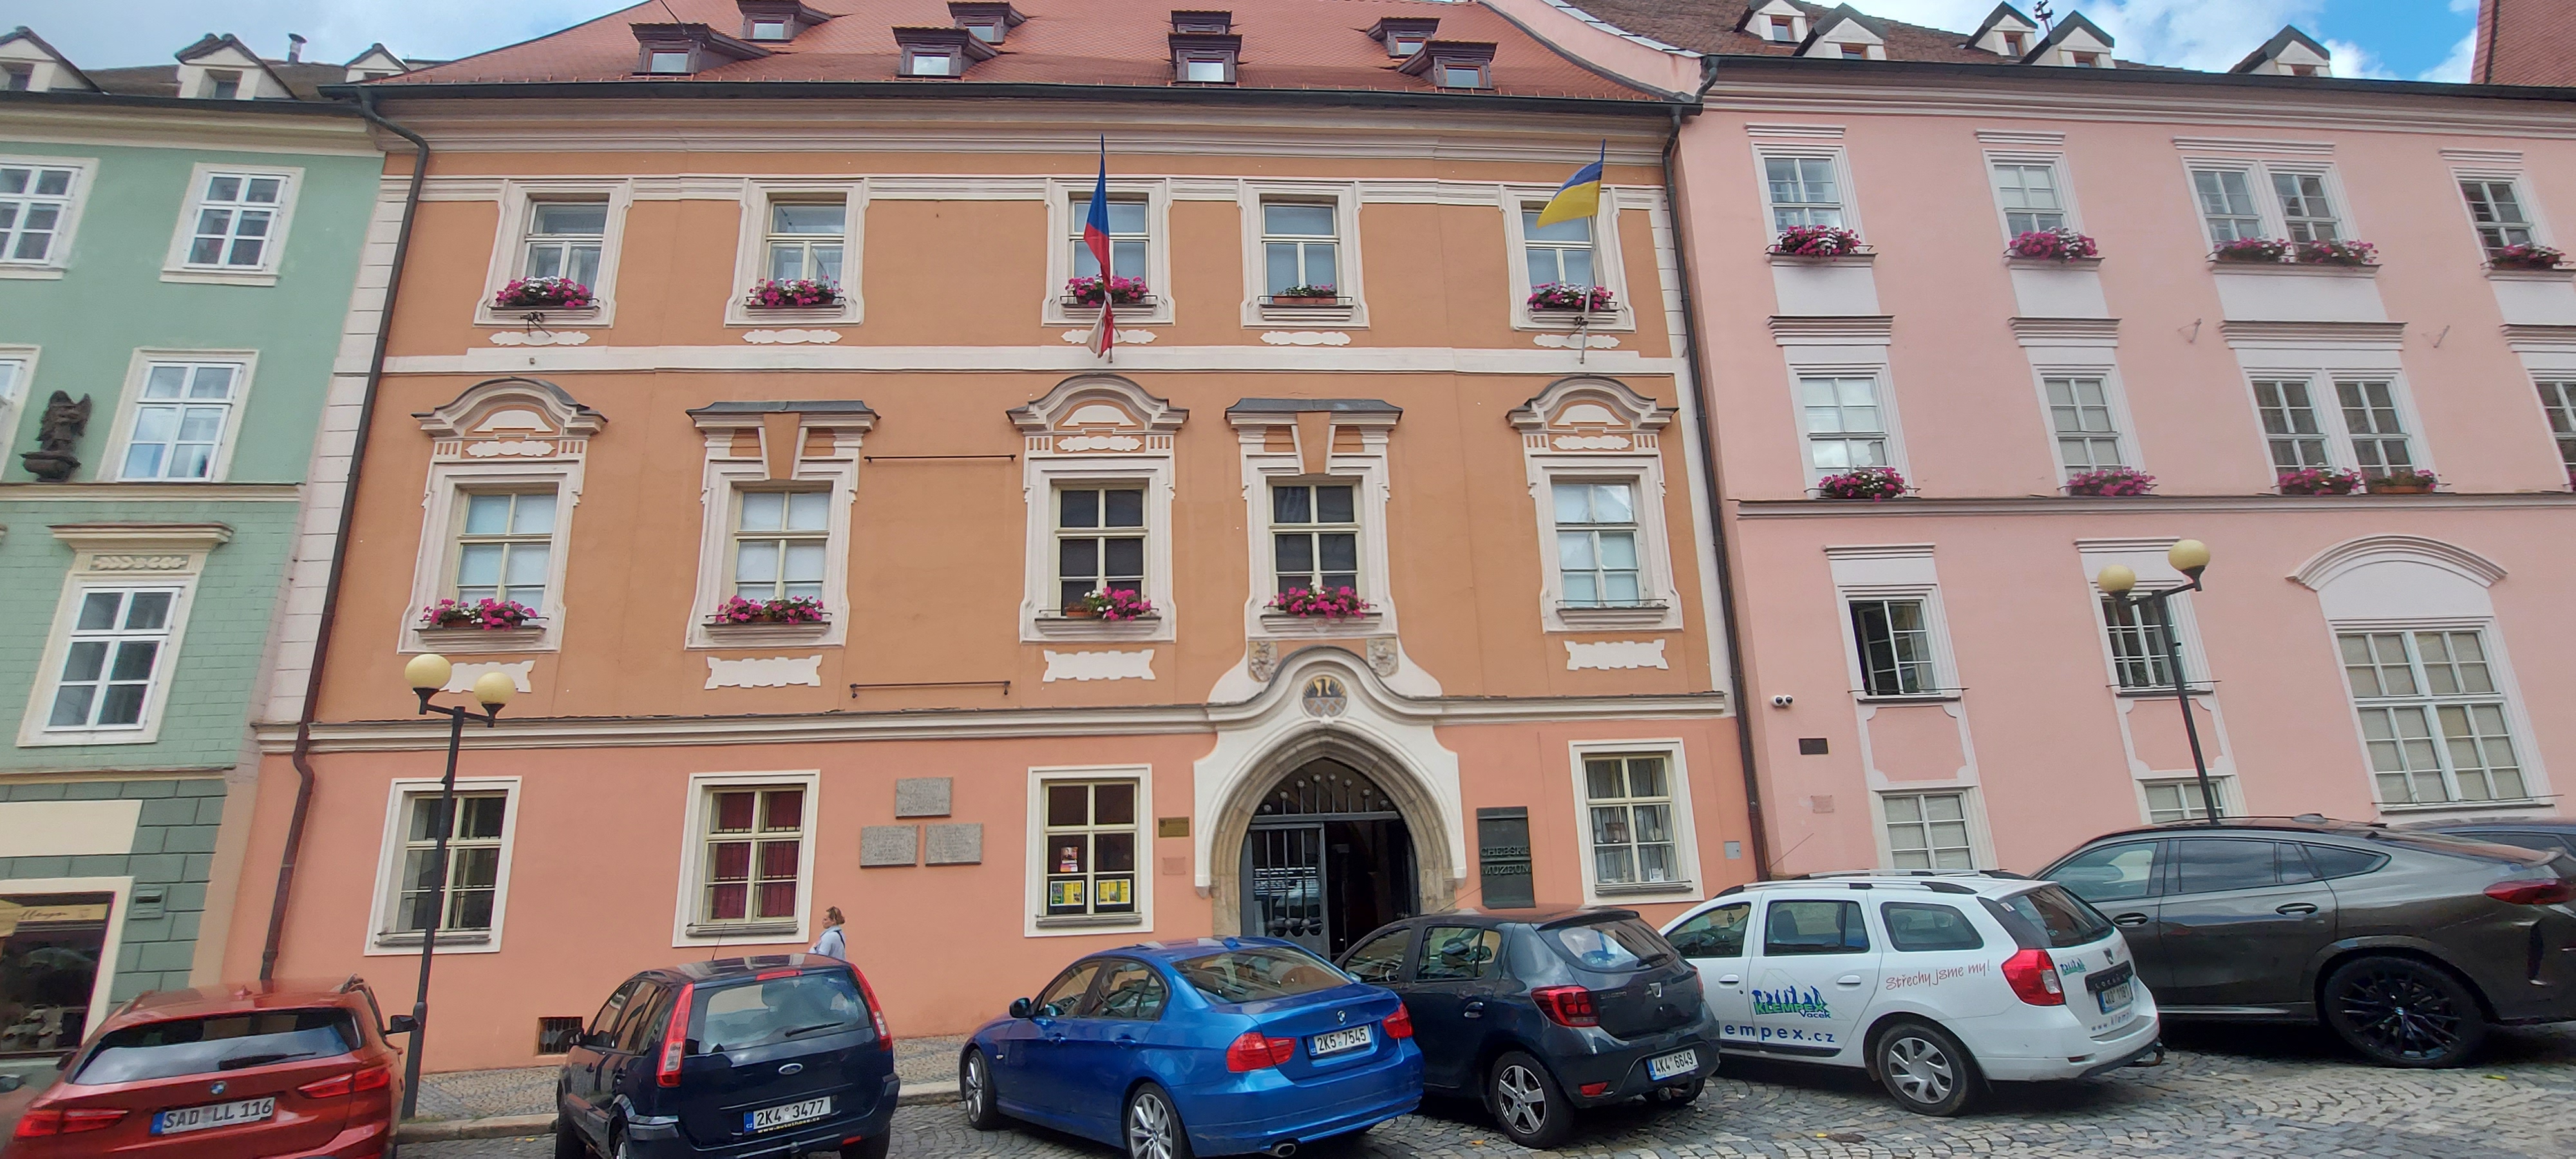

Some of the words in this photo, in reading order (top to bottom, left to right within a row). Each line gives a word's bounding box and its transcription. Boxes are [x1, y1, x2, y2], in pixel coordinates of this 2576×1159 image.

[1481, 864, 1531, 875] MUZEUM
[1886, 970, 1931, 990] Střechy
[1931, 966, 1964, 986] jsme
[1967, 959, 1990, 977] my!
[1754, 1001, 1830, 1015] KLEMPEX
[1799, 1009, 1832, 1019] Vacek
[1317, 1035, 1336, 1051] 2K5
[1342, 1028, 1366, 1046] 7545
[1655, 1058, 1671, 1073] 4K4
[1674, 1052, 1693, 1068] 6649
[164, 1110, 199, 1127] SAD
[213, 1105, 234, 1122] LL
[240, 1100, 272, 1117] 116
[757, 1109, 781, 1126] 2K4
[792, 1100, 824, 1118] 3477
